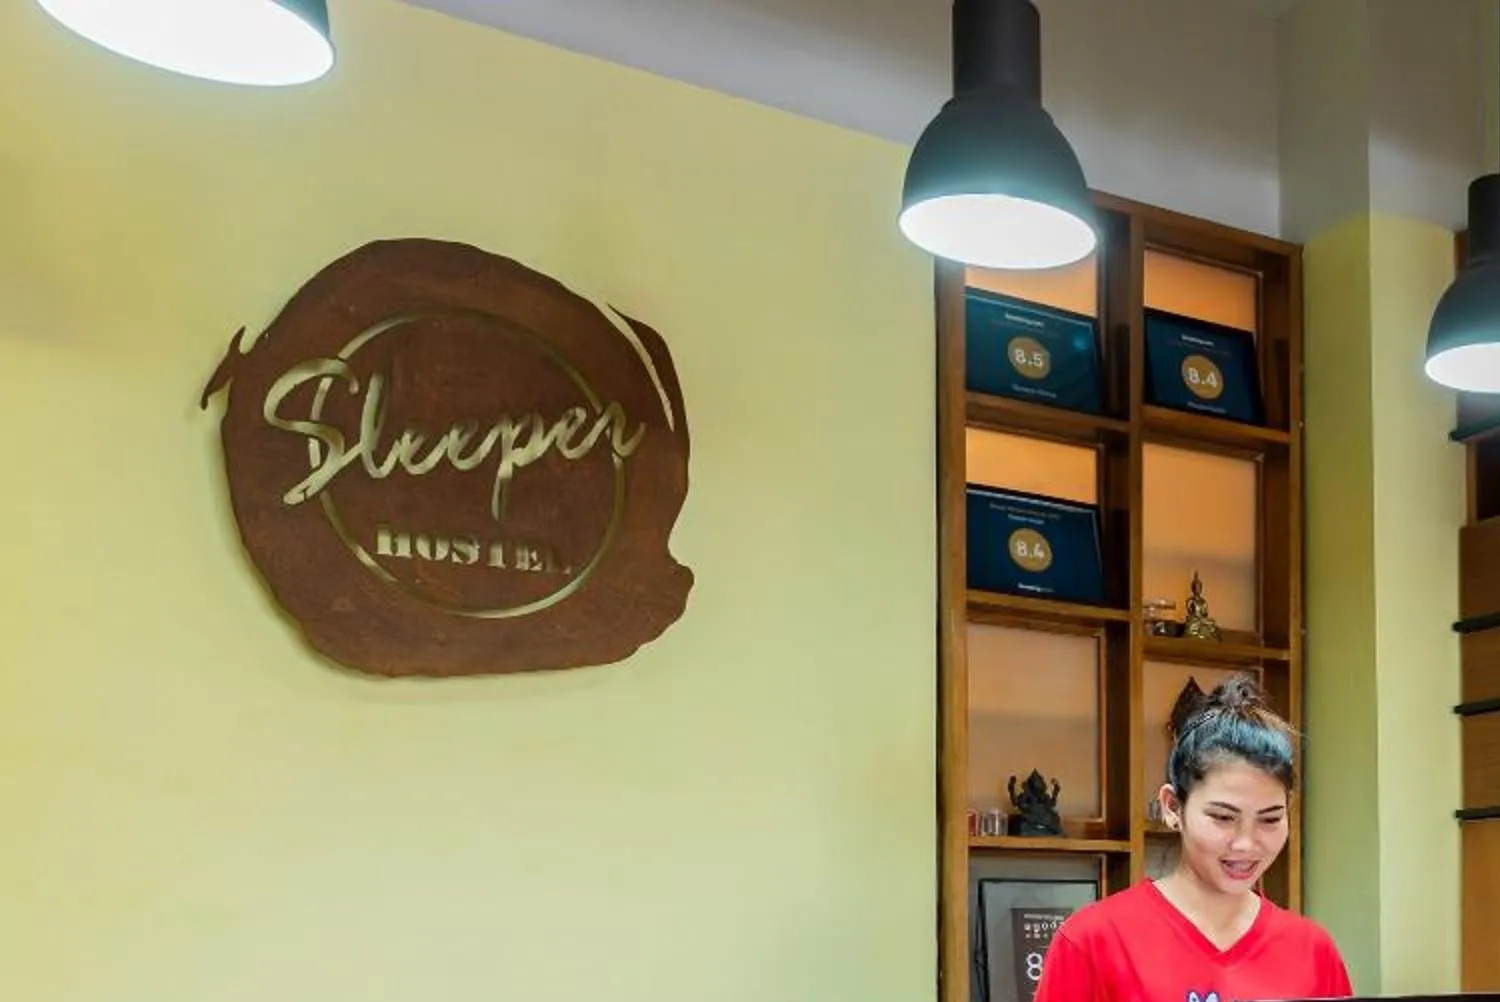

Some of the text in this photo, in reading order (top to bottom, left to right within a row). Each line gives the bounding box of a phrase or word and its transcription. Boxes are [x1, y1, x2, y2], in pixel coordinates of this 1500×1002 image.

[1013, 348, 1044, 369] 8.5
[1186, 366, 1218, 389] 8.4
[263, 357, 647, 521] Sleeper
